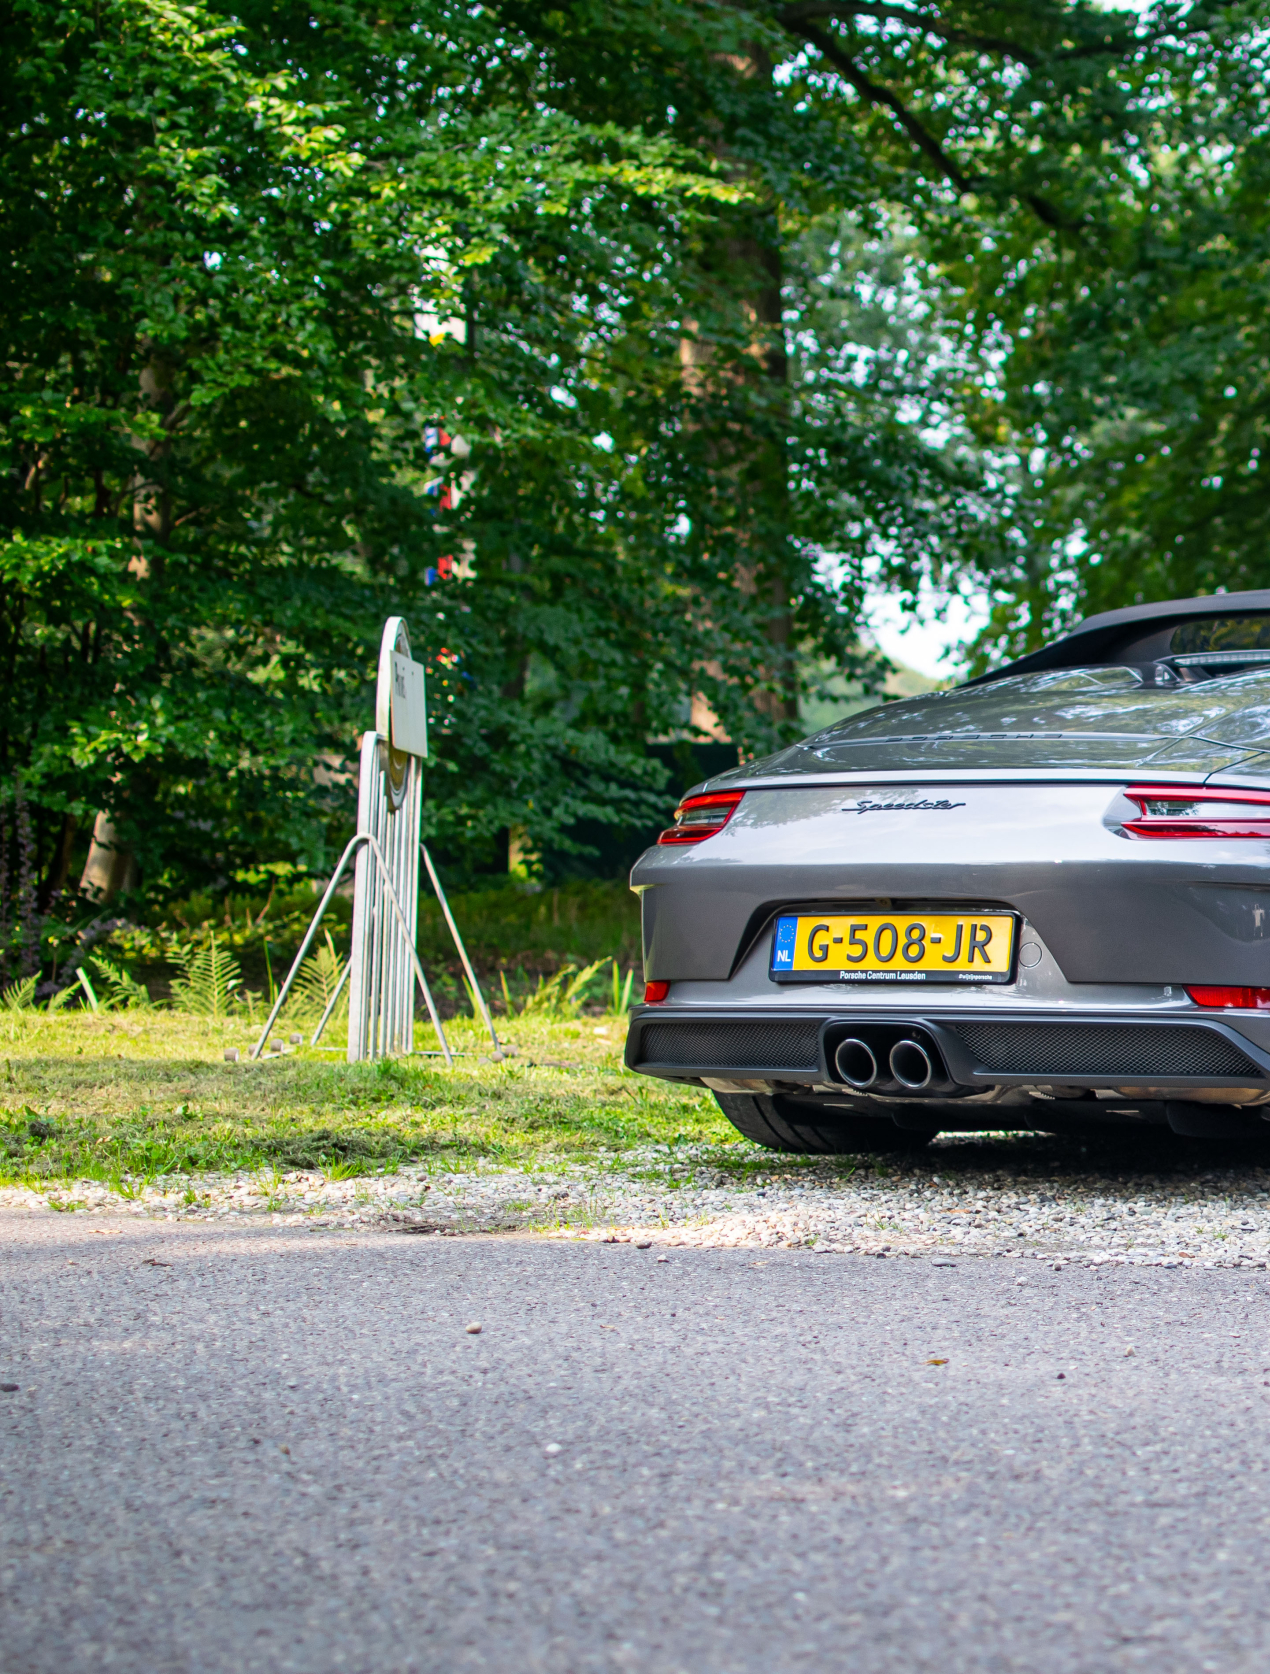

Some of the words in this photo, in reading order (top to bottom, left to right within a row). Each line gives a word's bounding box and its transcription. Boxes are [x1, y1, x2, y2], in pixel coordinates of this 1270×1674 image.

[841, 799, 966, 815] Speedster
[807, 922, 993, 964] G-508-JR
[777, 950, 791, 962] NL
[839, 971, 866, 980] Porsche
[867, 971, 896, 980] Centrum
[897, 972, 926, 980] Leusden
